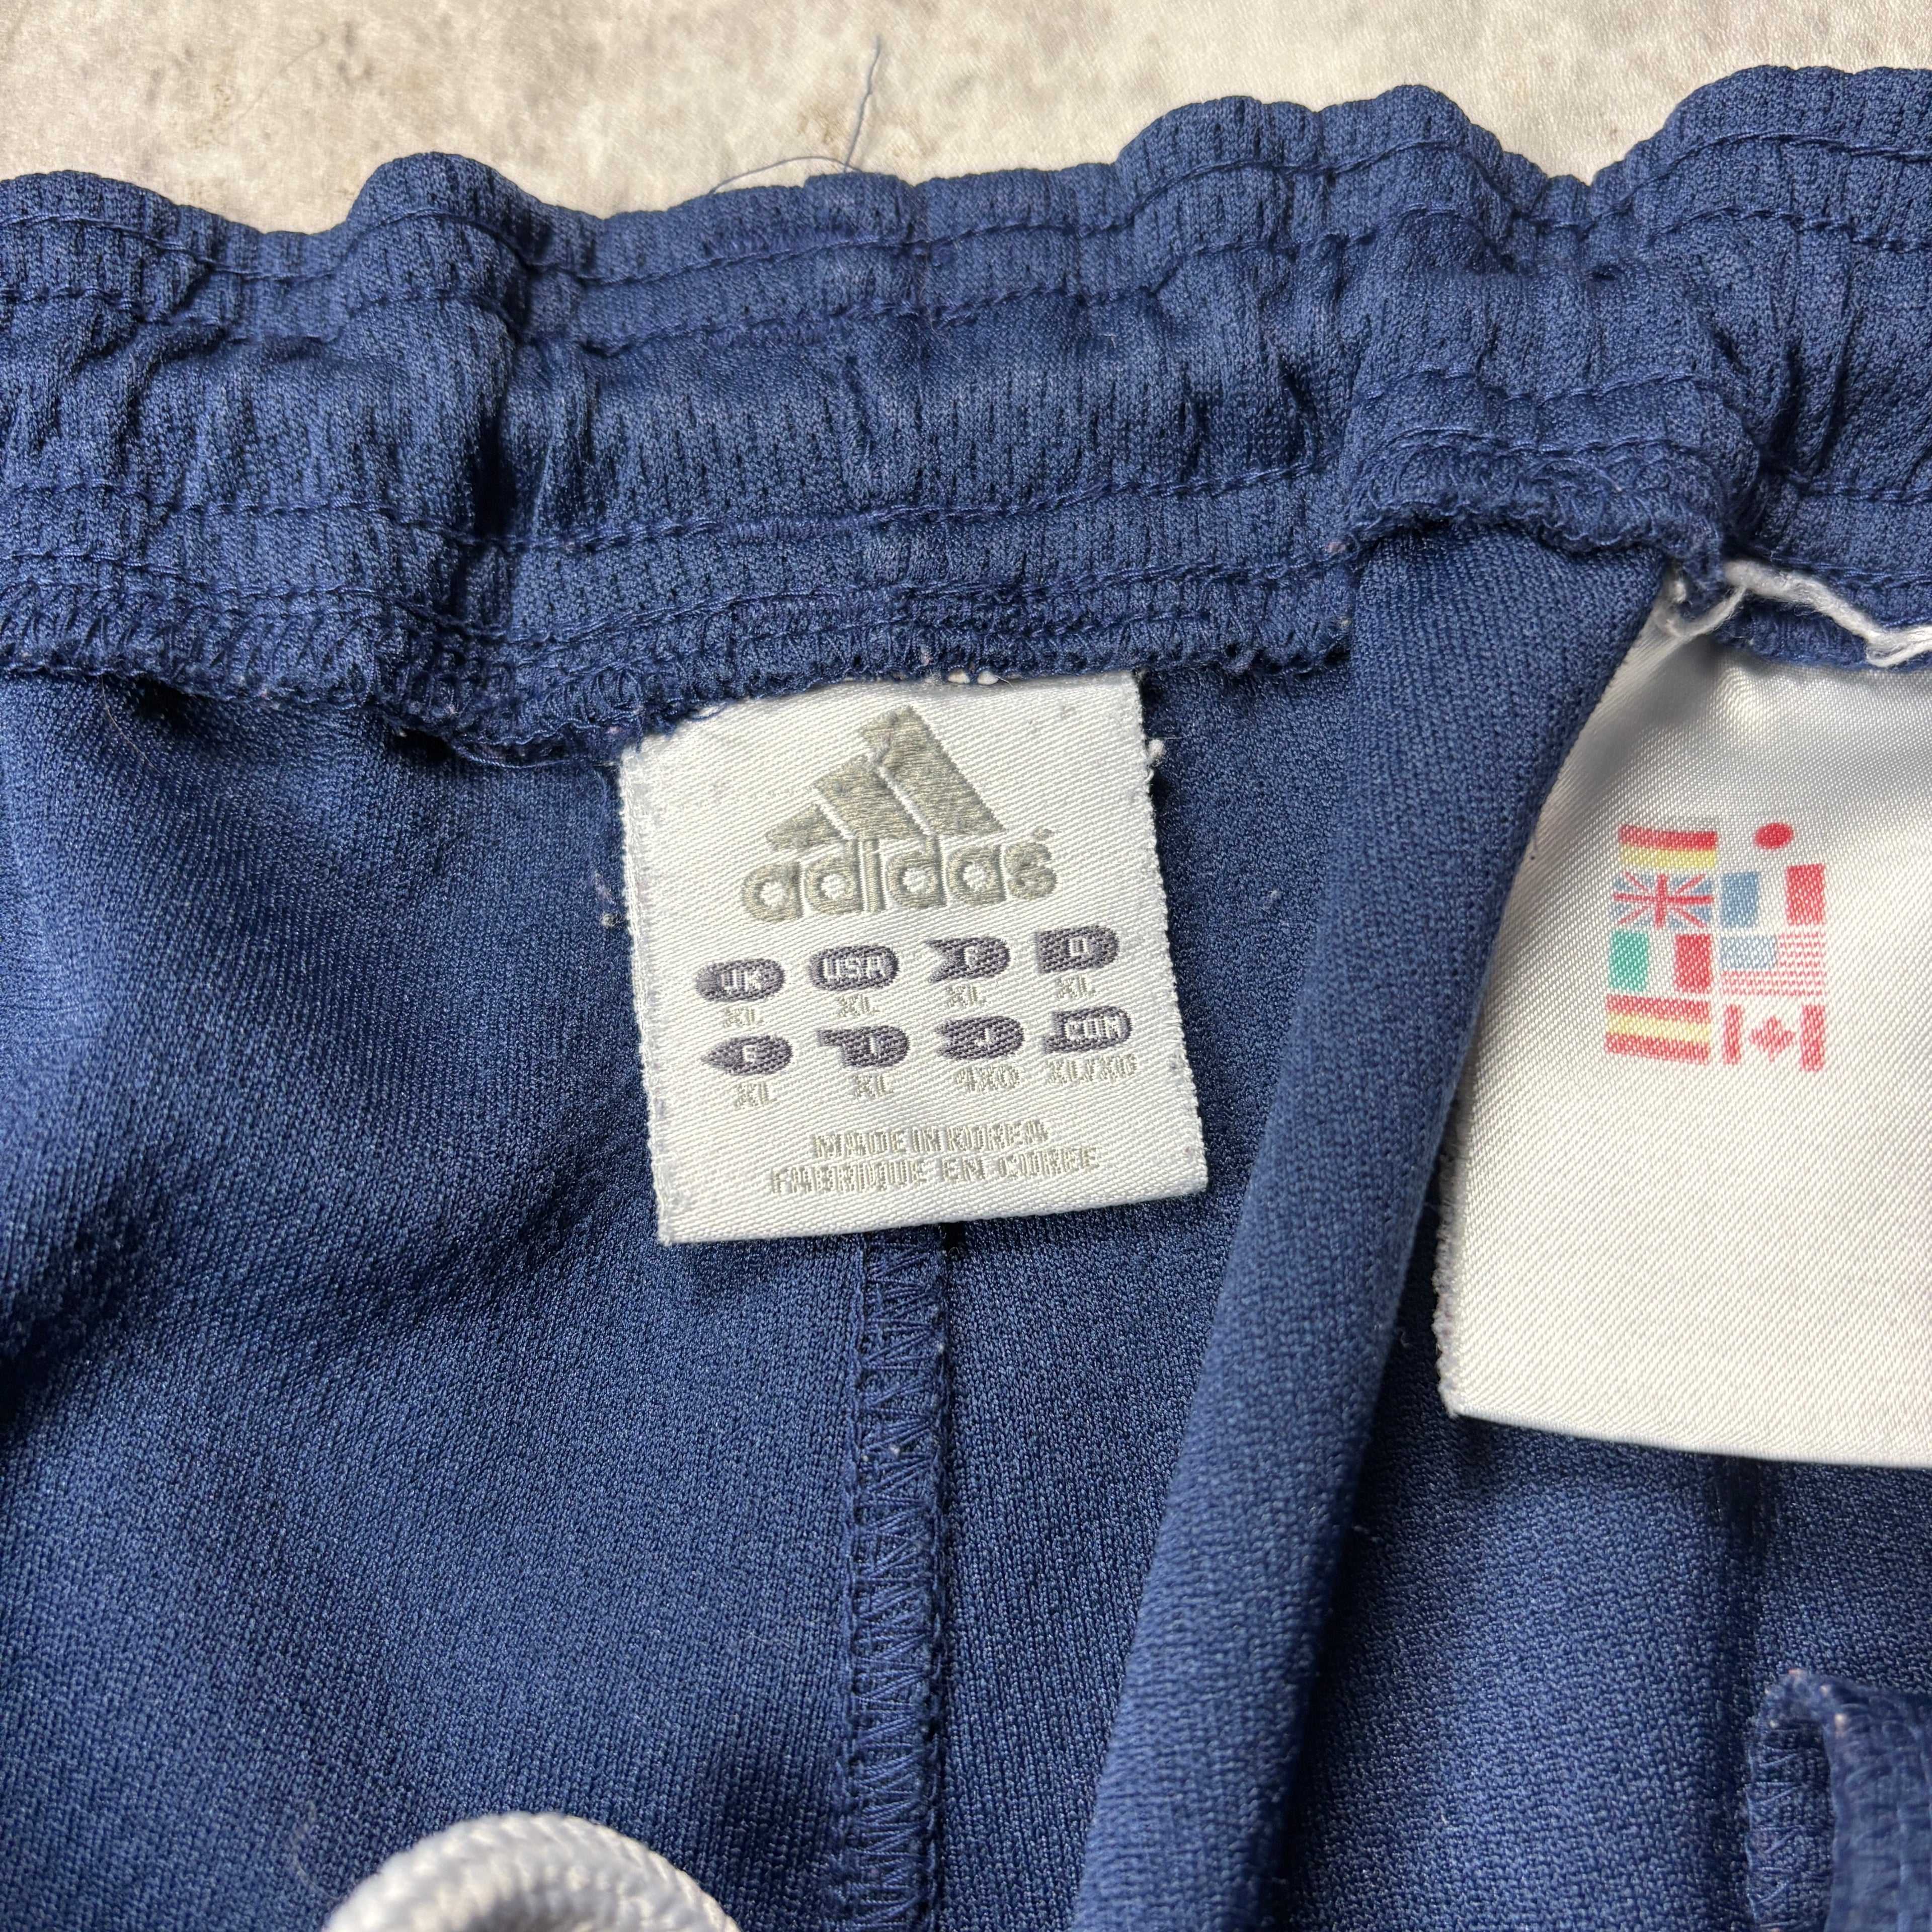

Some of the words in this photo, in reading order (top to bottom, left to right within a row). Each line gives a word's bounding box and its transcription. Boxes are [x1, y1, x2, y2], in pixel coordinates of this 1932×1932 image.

[744, 837, 1057, 922] adidas
[720, 968, 763, 992] UK
[823, 955, 884, 980] USA
[814, 1131, 907, 1158] MADE
[912, 1126, 941, 1154] IN
[946, 1119, 1050, 1152] KOREA
[772, 1158, 927, 1194] FABRIQUE
[942, 1156, 986, 1182] EN
